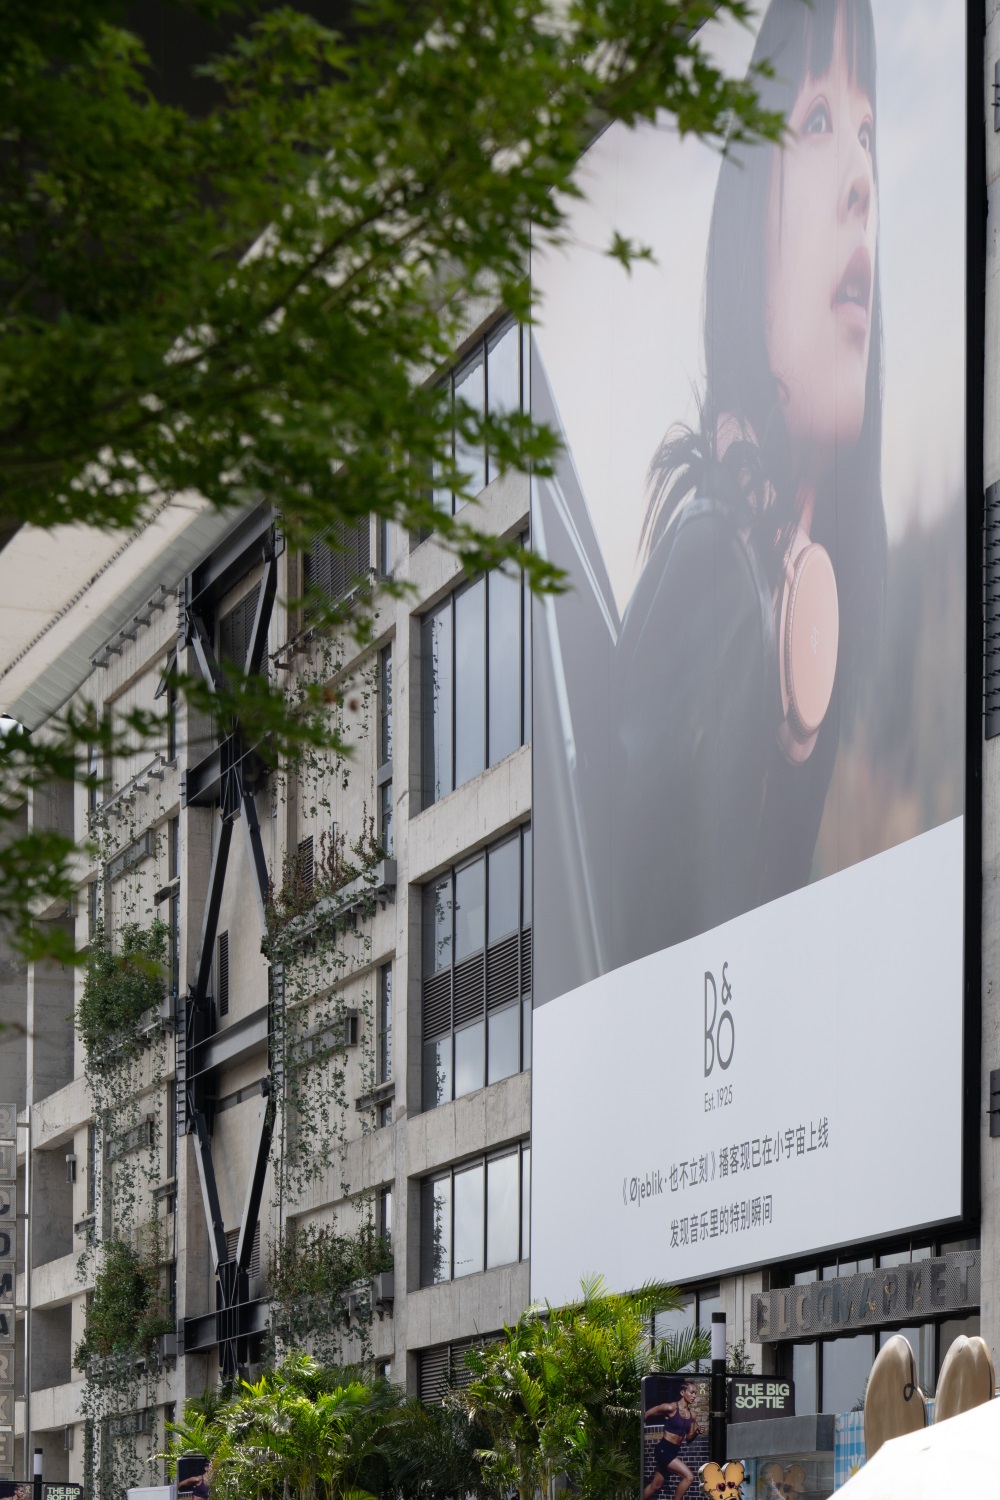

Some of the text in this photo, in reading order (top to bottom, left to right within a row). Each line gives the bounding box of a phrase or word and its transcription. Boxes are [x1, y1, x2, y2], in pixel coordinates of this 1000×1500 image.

[704, 1084, 733, 1112] Est. 1925
[669, 1194, 773, 1248] 发现音乐里的特别瞬间
[735, 1383, 790, 1396] THE BIG
[735, 1396, 785, 1409] SOFTIE
[47, 1486, 80, 1495] THE BIG
